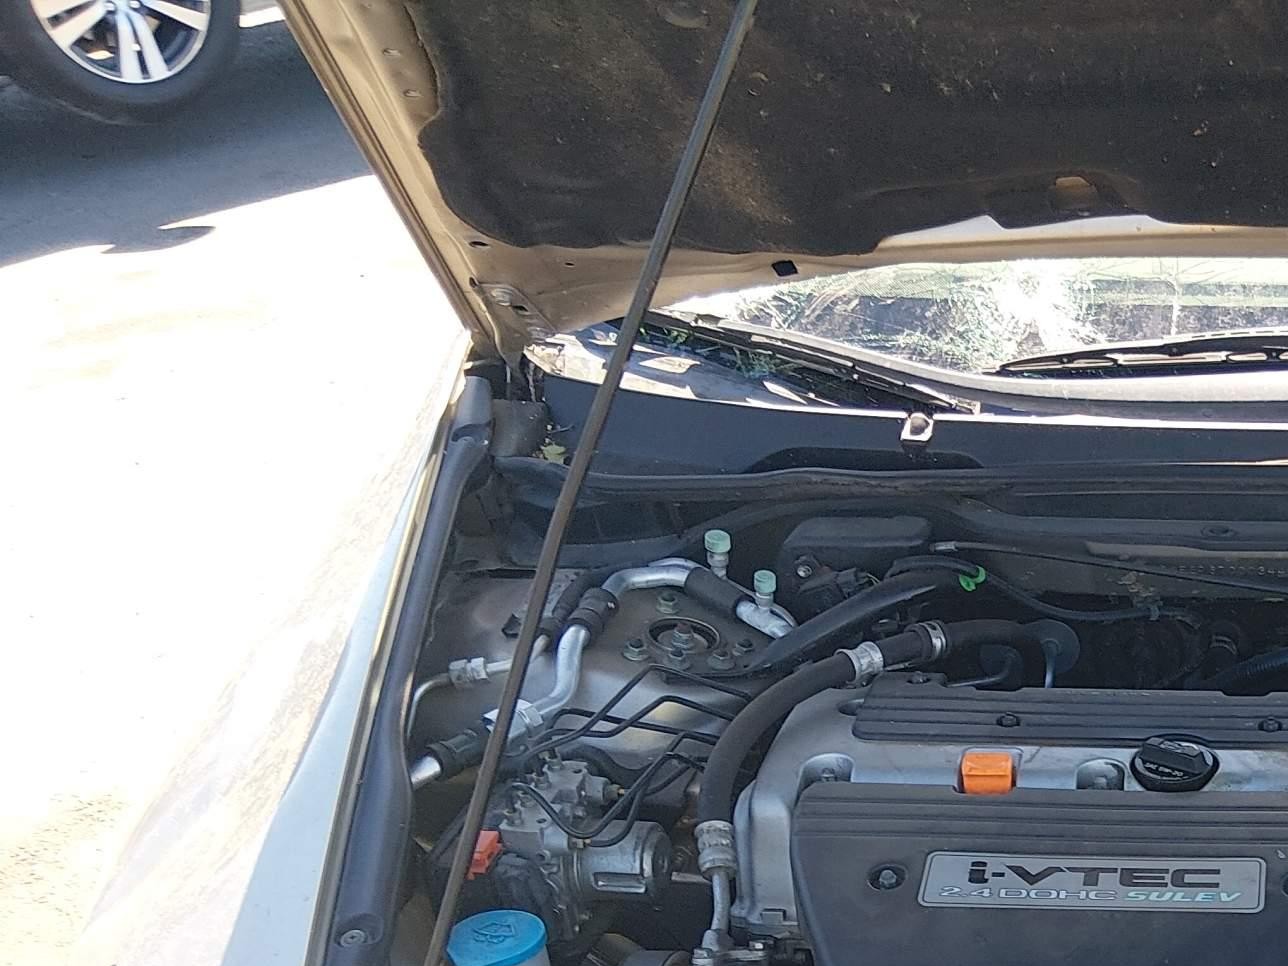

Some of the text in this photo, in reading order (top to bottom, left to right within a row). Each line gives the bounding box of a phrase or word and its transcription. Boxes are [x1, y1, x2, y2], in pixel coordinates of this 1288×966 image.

[968, 861, 1221, 888] i-VTEC
[940, 886, 1242, 903] 2.4 DOHC SULEV
